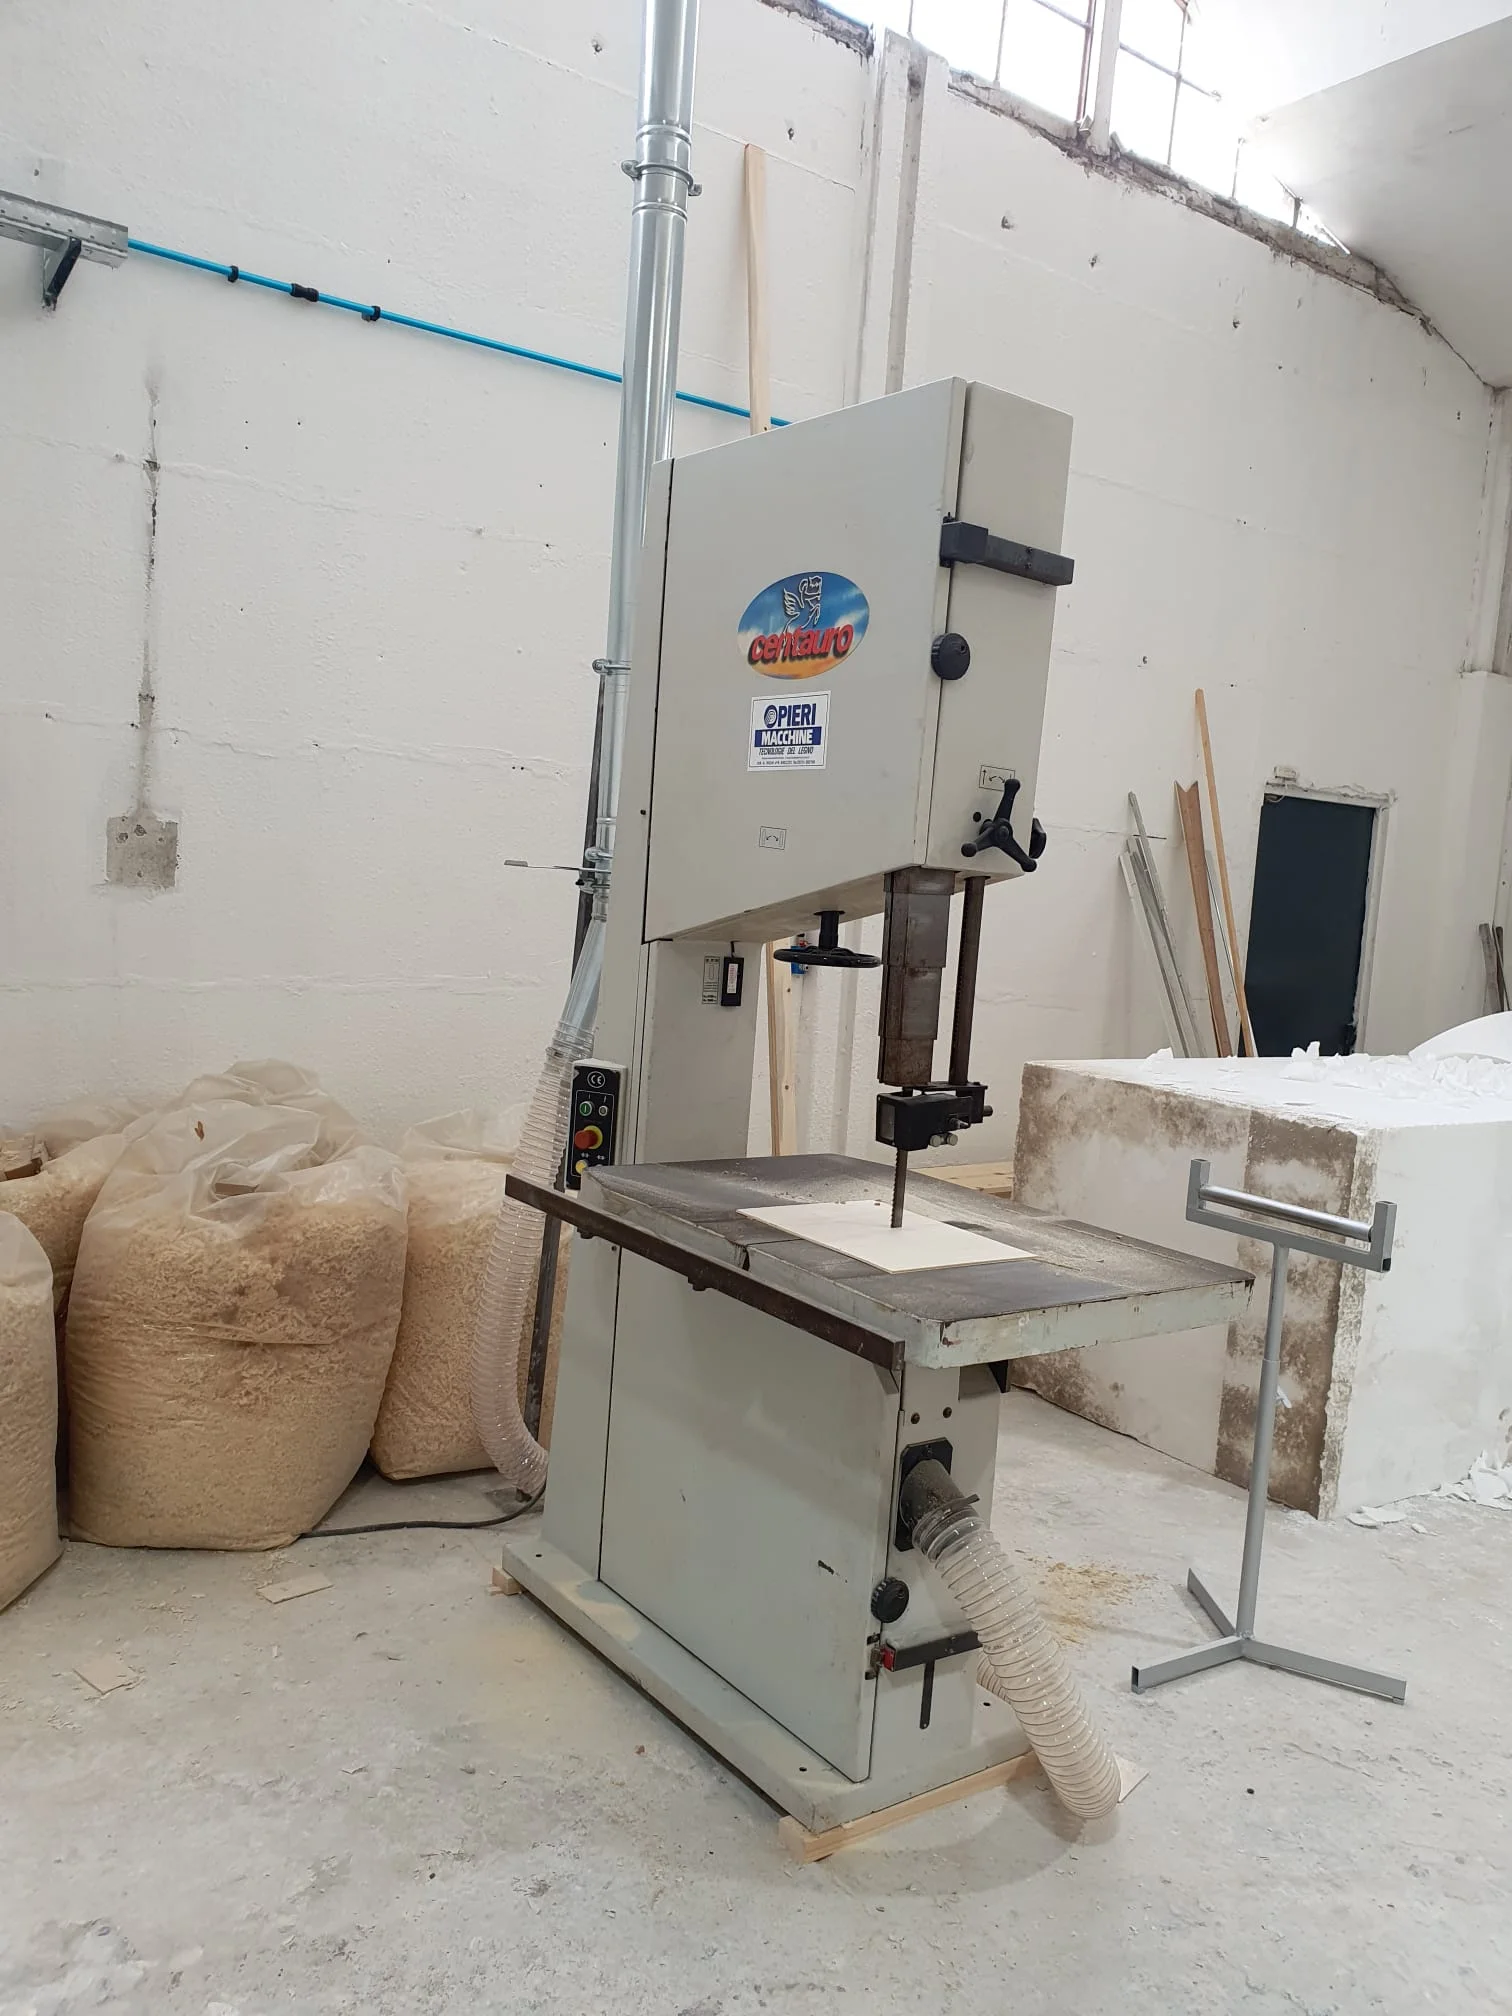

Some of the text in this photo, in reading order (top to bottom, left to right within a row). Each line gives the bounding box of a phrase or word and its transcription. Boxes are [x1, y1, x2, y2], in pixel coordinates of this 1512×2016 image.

[750, 624, 854, 663] centauro
[777, 703, 816, 727] PIERI
[761, 729, 813, 746] MACCHINE
[786, 747, 796, 755] DEL
[798, 746, 814, 755] LEGNO
